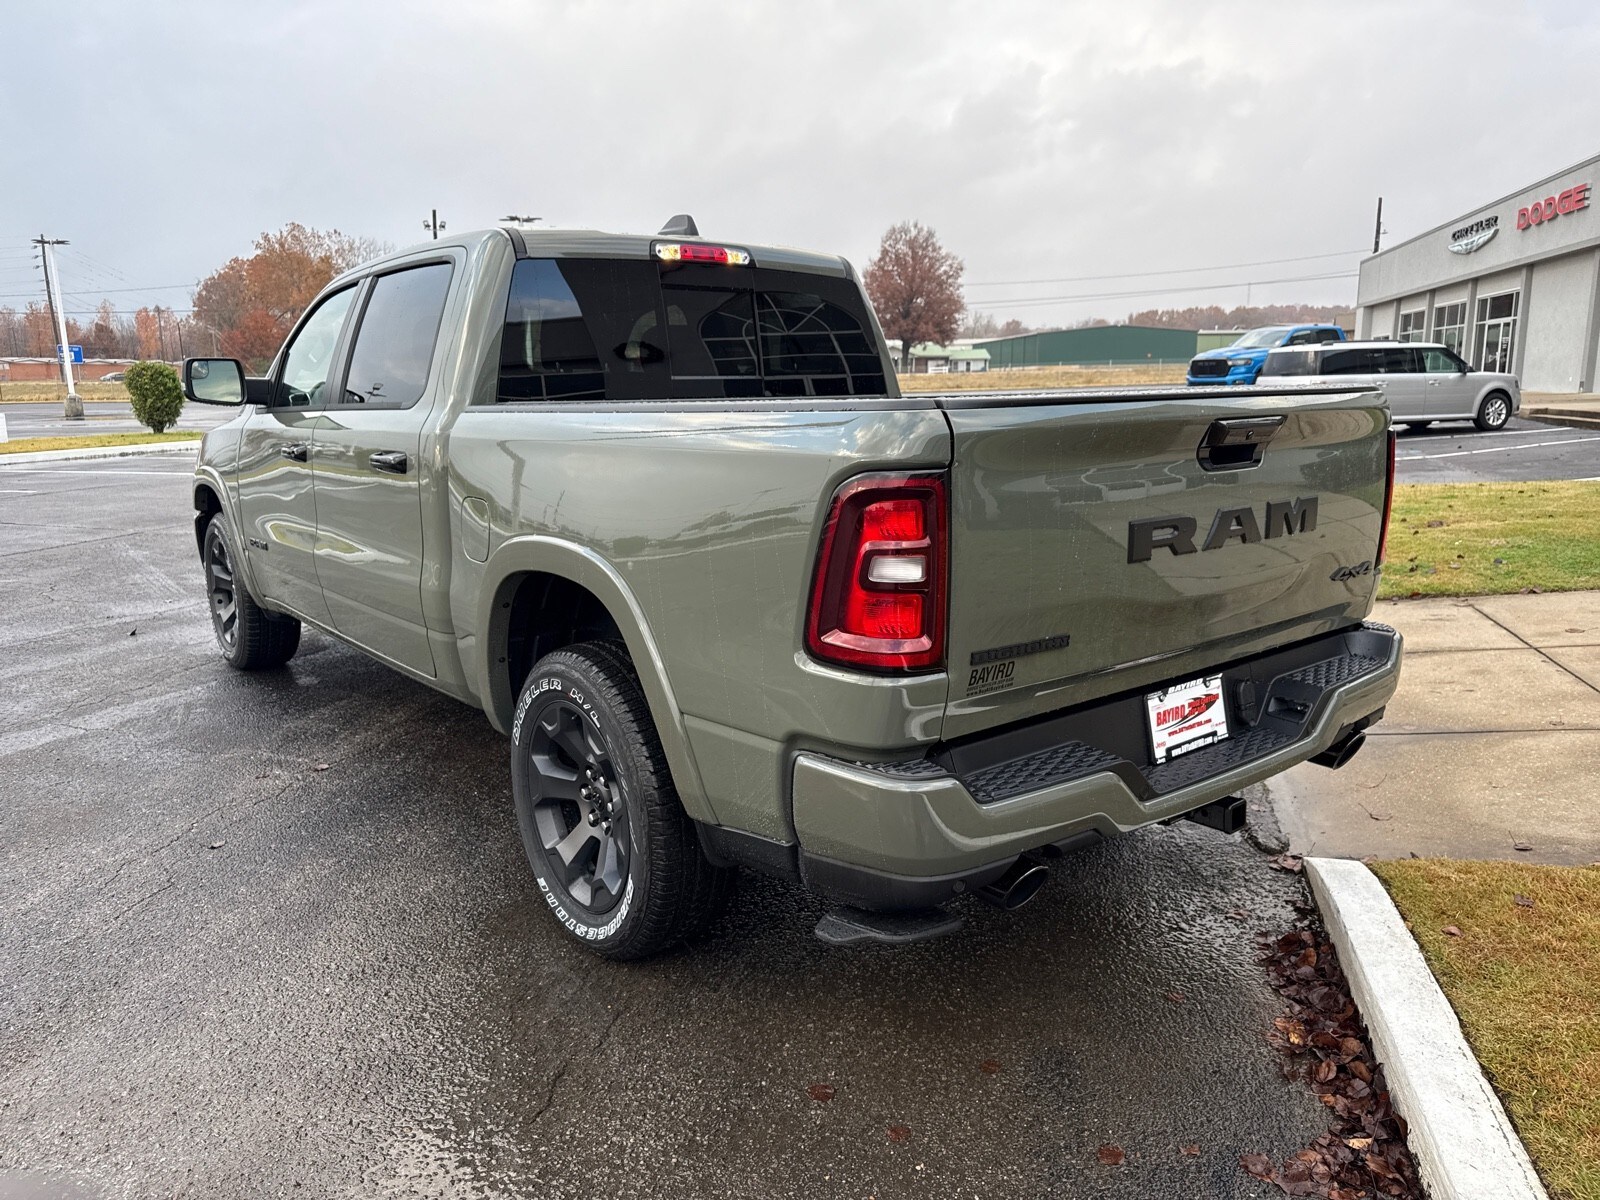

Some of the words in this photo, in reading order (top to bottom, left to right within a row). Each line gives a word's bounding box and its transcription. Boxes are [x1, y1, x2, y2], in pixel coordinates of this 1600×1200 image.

[1516, 183, 1592, 231] DODGE
[1127, 496, 1319, 565] RAM
[968, 660, 1015, 686] BAYIRD
[1168, 678, 1204, 694] BAYIRD
[512, 678, 562, 746] DUELER
[1156, 704, 1186, 727] BAYIRD
[536, 873, 634, 940] BRIDGESTONE
